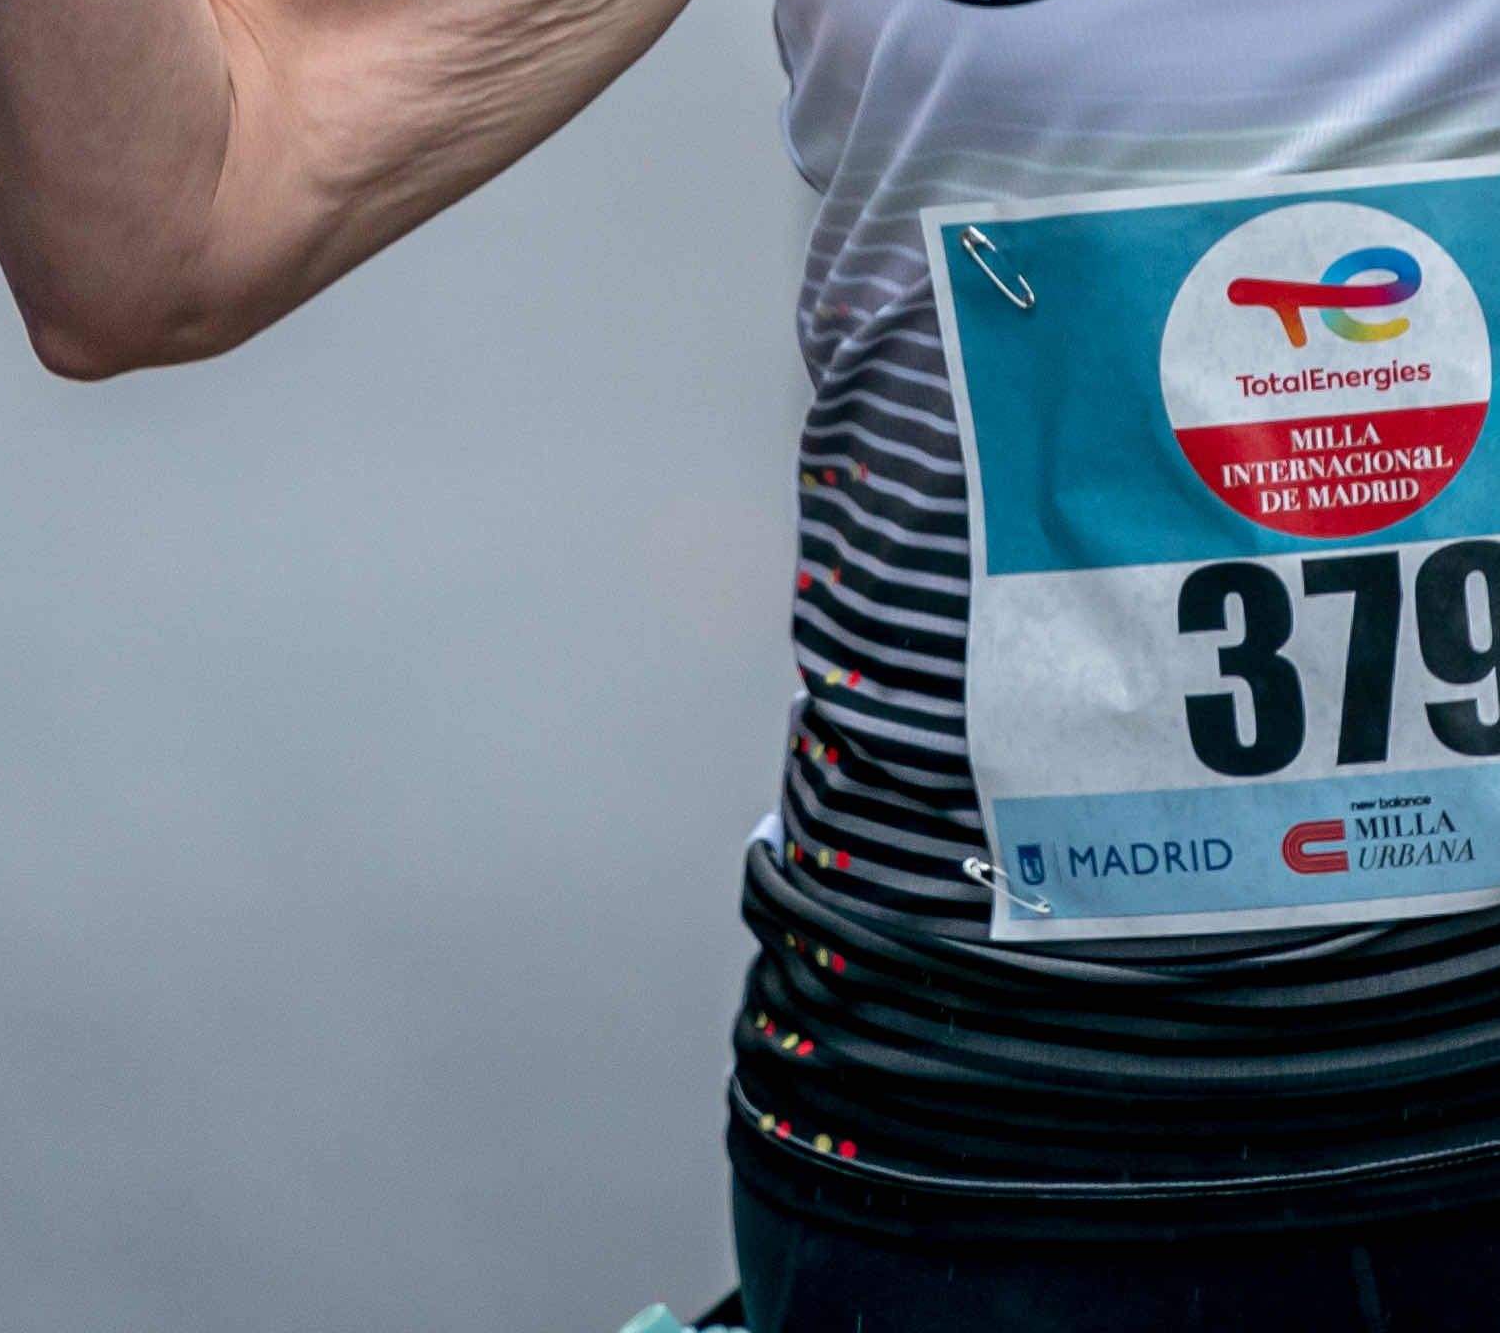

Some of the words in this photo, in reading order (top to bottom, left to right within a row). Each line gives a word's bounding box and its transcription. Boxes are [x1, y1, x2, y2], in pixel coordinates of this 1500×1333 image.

[1236, 359, 1432, 397] TotalEnergies
[1290, 421, 1381, 453] MILLA
[1260, 488, 1301, 514] DE
[1308, 477, 1420, 510] MADRID
[1351, 802, 1375, 811] new
[1379, 795, 1431, 809] balance
[1354, 809, 1458, 841] MILLA
[1068, 838, 1233, 878] MADRID
[1358, 836, 1476, 871] URBANA
